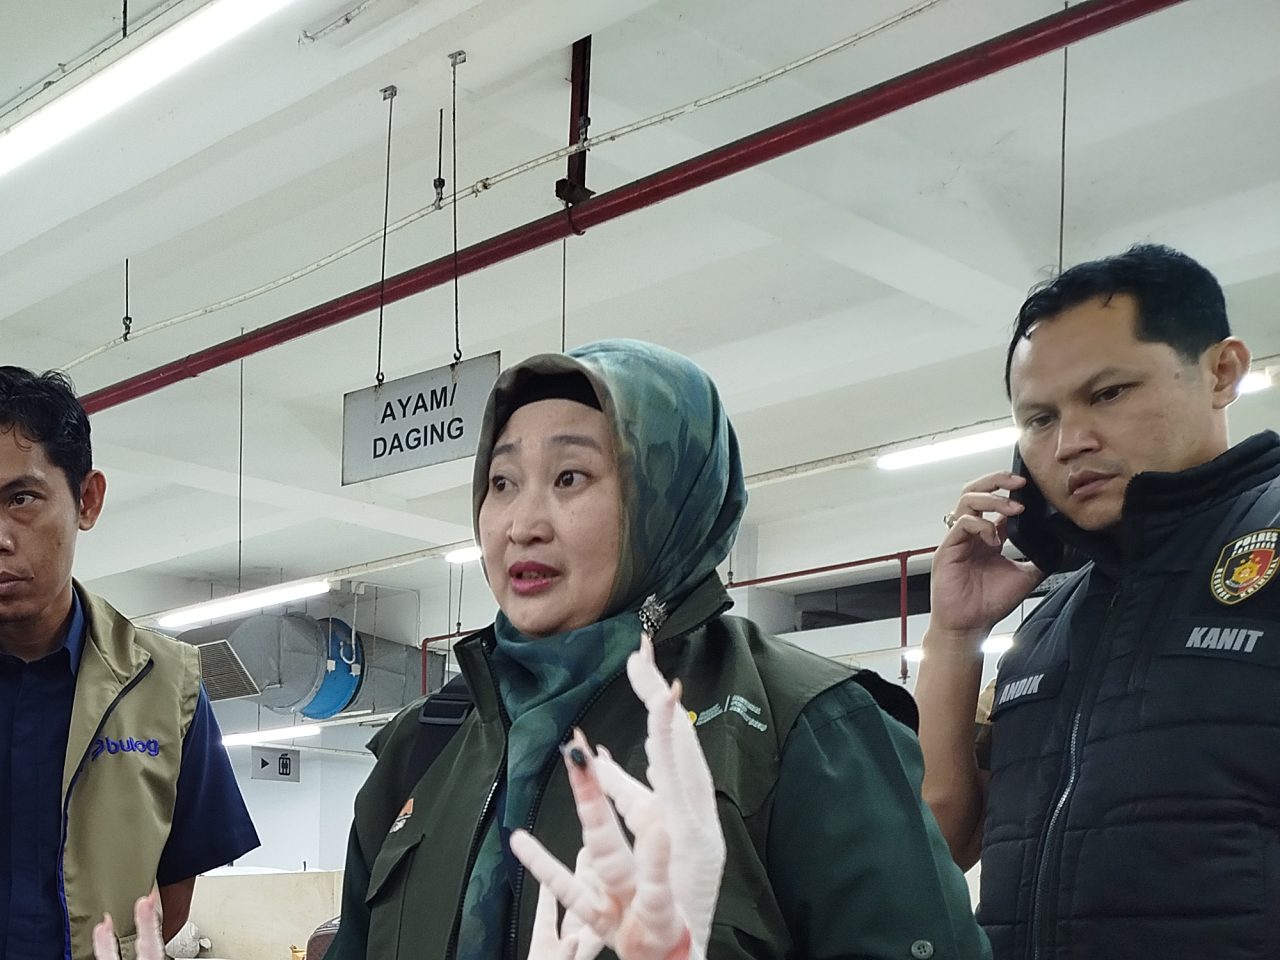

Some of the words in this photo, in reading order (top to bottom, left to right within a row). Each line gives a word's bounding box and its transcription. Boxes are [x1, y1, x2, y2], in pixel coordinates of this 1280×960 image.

[380, 383, 457, 424] AYAM/
[372, 417, 464, 459] DAGING
[1185, 627, 1264, 653] KANIT
[105, 736, 159, 757] bulog
